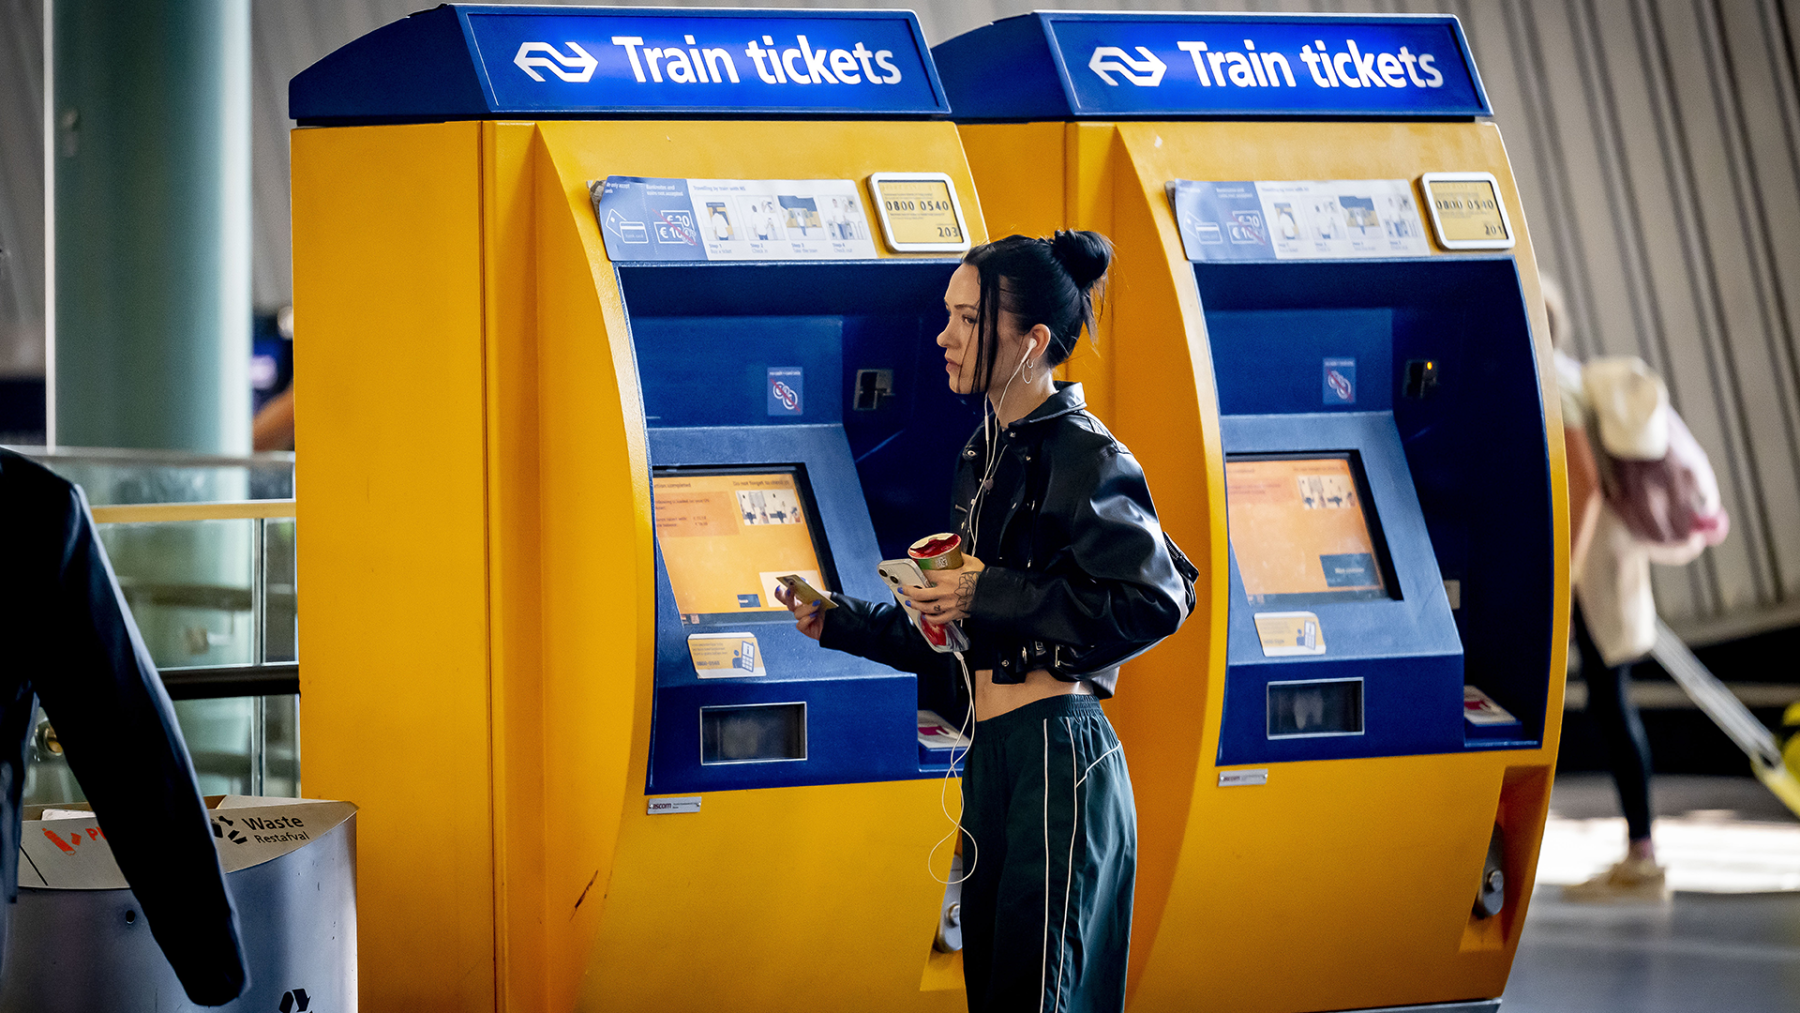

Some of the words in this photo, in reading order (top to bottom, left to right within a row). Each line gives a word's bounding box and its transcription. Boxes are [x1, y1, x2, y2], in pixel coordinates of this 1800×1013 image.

[611, 35, 740, 83] Train
[745, 35, 902, 85] tickets
[1177, 39, 1296, 87] Train
[1300, 39, 1444, 88] tickets
[886, 200, 915, 211] 0800
[920, 200, 949, 211] 0540
[1436, 200, 1463, 210] 0800
[937, 226, 959, 238] 203
[652, 802, 672, 810] ascom
[241, 815, 304, 831] Waste
[253, 831, 310, 845] Restafval
